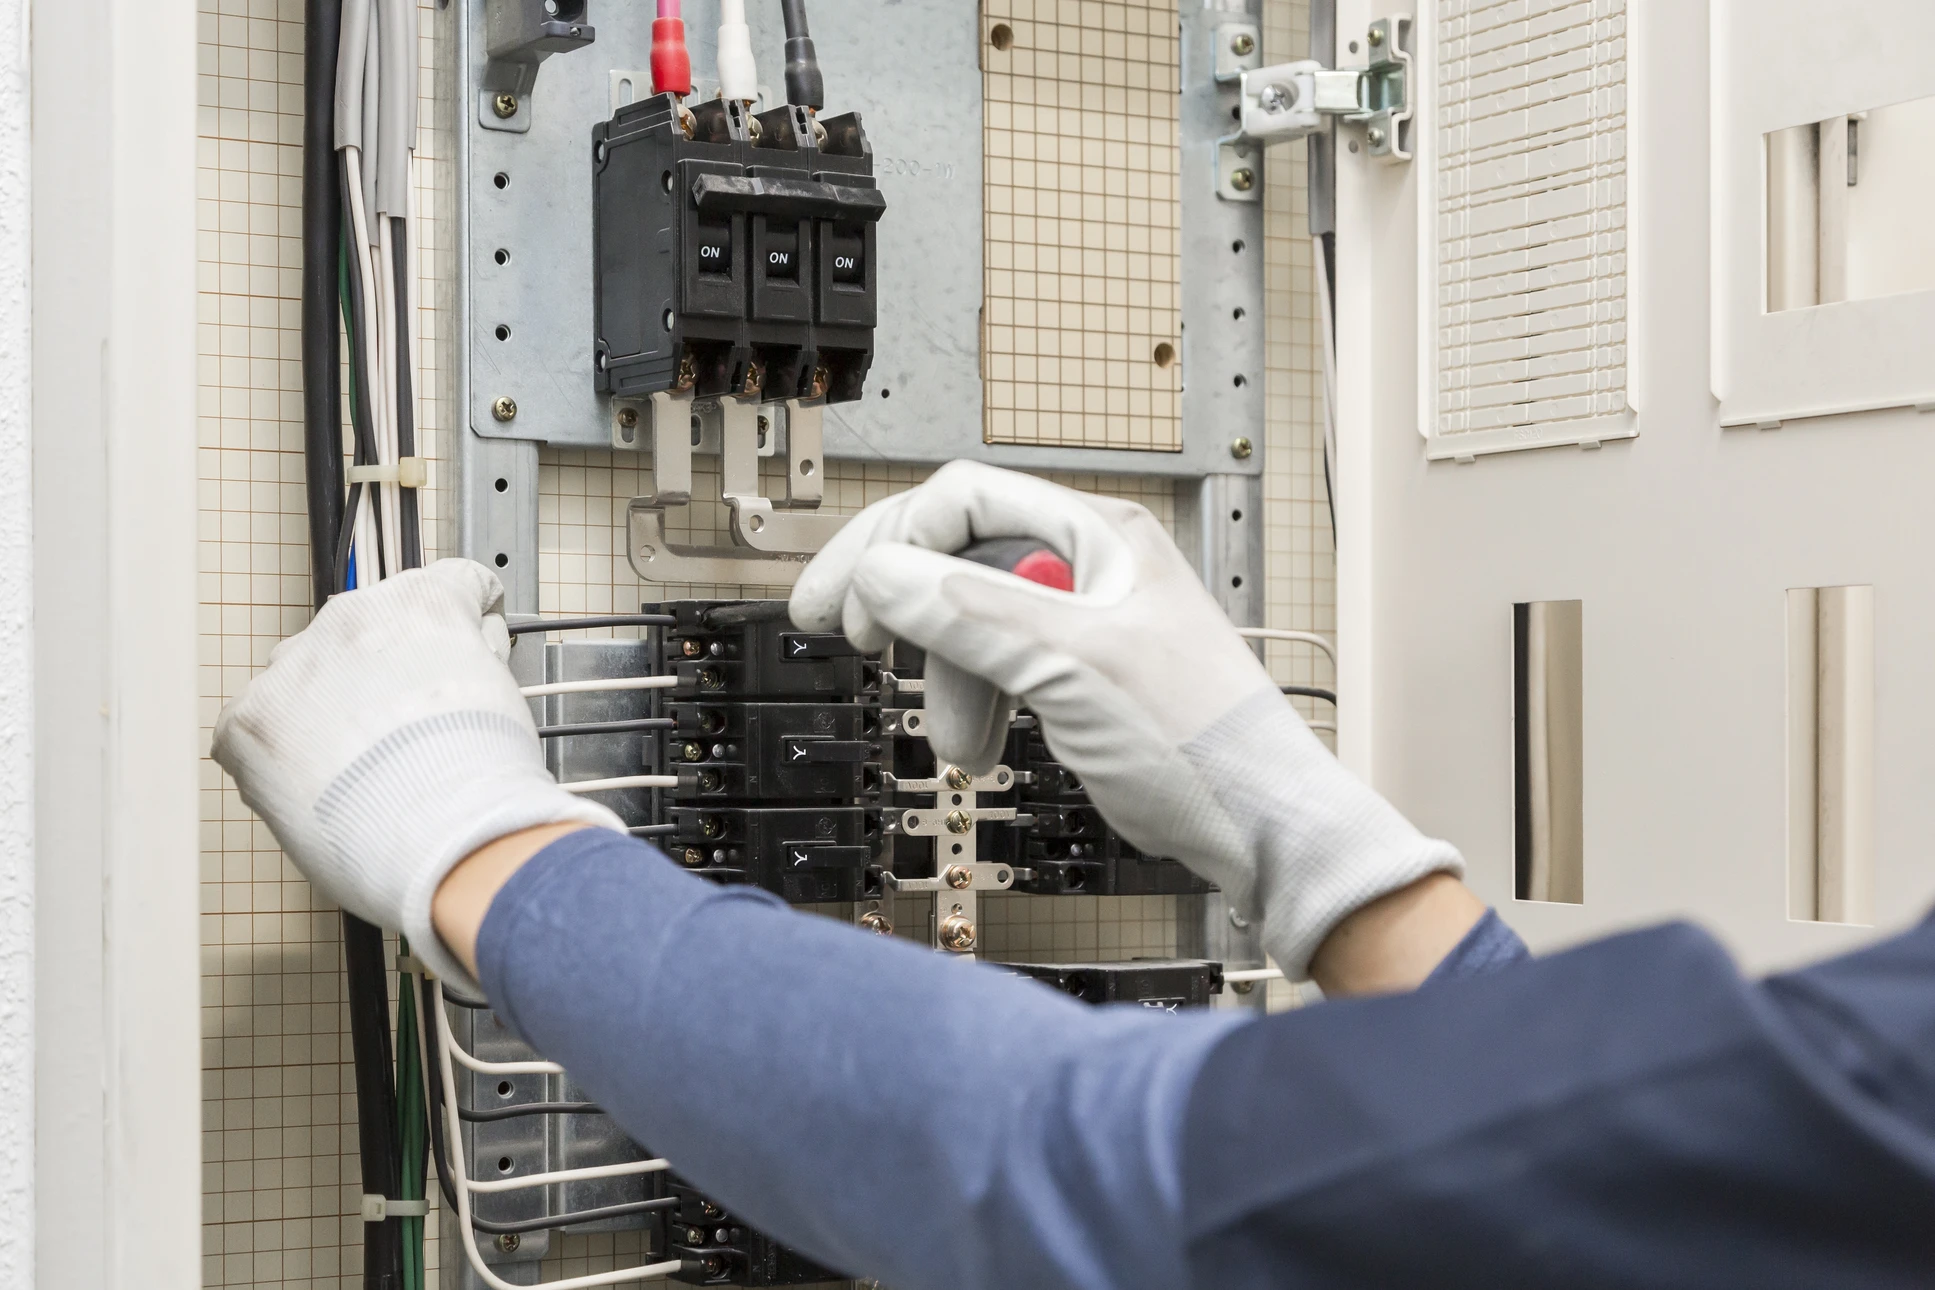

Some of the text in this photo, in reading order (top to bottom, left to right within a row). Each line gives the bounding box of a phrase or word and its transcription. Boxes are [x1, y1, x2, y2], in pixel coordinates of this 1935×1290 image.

[700, 245, 720, 258] ON
[769, 251, 788, 264] ON
[835, 256, 854, 269] ON
